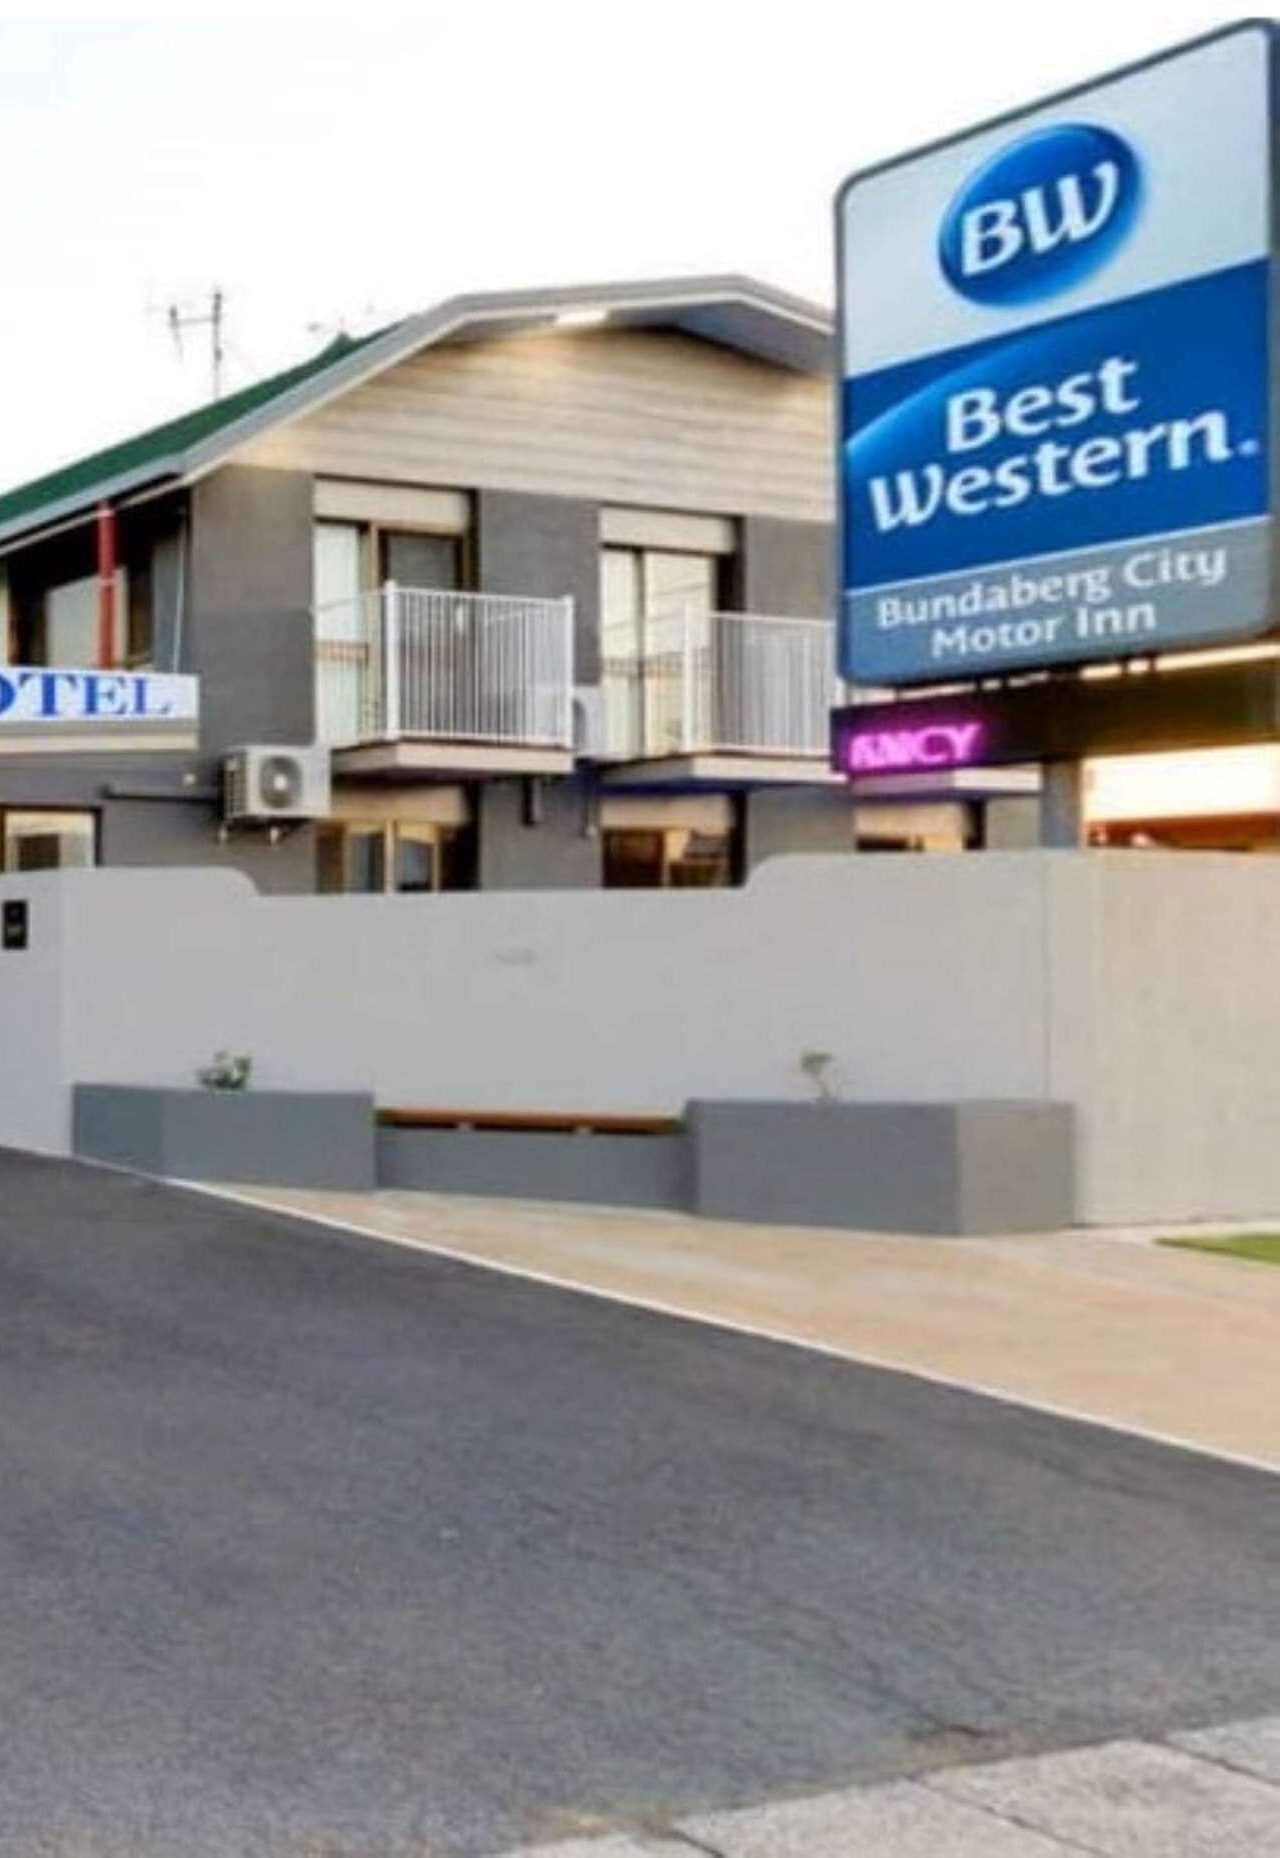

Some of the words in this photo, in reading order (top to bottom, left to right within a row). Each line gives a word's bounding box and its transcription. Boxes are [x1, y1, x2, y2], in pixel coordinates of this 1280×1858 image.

[959, 158, 1121, 278] BW
[945, 355, 1141, 453] Best
[876, 567, 1110, 631] Bundaberg
[1122, 545, 1228, 588] City
[930, 612, 1064, 659] Motor
[1075, 600, 1157, 637] Inn
